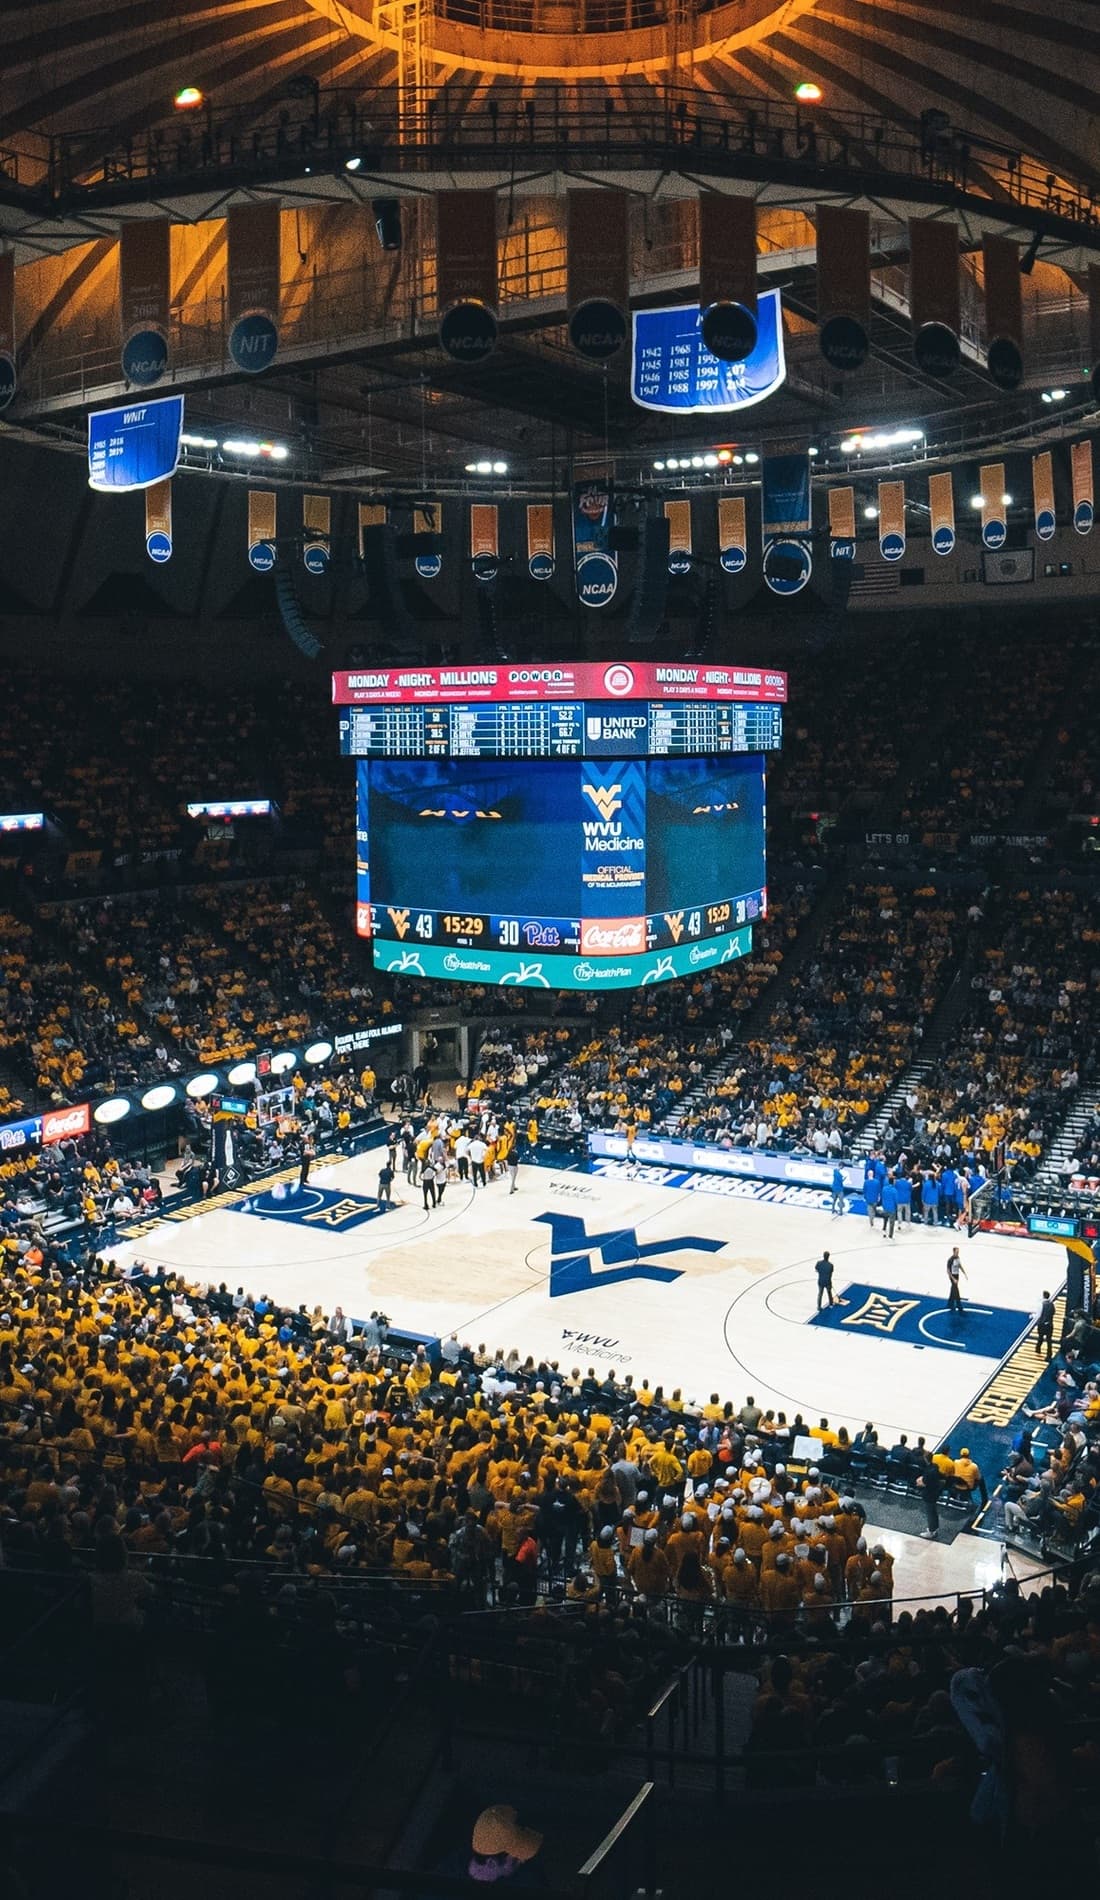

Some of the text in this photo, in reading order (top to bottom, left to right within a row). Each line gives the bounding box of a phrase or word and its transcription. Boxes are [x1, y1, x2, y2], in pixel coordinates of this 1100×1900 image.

[240, 335, 271, 354] NIT
[449, 337, 497, 349] NCAA
[579, 332, 627, 345] NCAA
[642, 344, 692, 358] 1942 1968
[131, 361, 166, 374] NCAA
[641, 360, 662, 371] 1945
[670, 358, 690, 368] 1981
[640, 372, 661, 384] 1946
[668, 370, 690, 381] 1985
[696, 367, 718, 378] 1994
[639, 380, 718, 396] 1947 1988 1997
[124, 409, 147, 424] WNIT
[835, 546, 851, 556] NIT
[582, 583, 615, 595] NCAA
[348, 674, 390, 688] MONDAY
[440, 671, 498, 686] MILLIONS
[509, 670, 562, 683] POWER
[656, 668, 699, 682] MONDAY
[733, 672, 762, 686] MILLIONS
[603, 716, 646, 728] UNITED
[603, 728, 636, 739] BANK
[556, 745, 560, 754] 4
[562, 745, 570, 754] OF
[418, 809, 503, 819] WVU
[692, 802, 740, 814] WVU
[582, 822, 622, 836] WVU
[586, 836, 644, 852] Medicine
[865, 833, 892, 844] LET'S
[896, 833, 910, 844] GO
[598, 866, 634, 874] OFFICIAL
[688, 911, 700, 936] 43
[707, 904, 730, 924] 15:29
[736, 900, 746, 923] 30
[416, 914, 560, 946] 43 15:29 30 Pitt
[583, 924, 644, 949] Coca-Cola
[45, 1110, 86, 1136] Coca-Cola
[560, 1184, 592, 1193] WVU
[576, 1332, 620, 1348] WVU
[562, 1342, 632, 1364] Medicine
